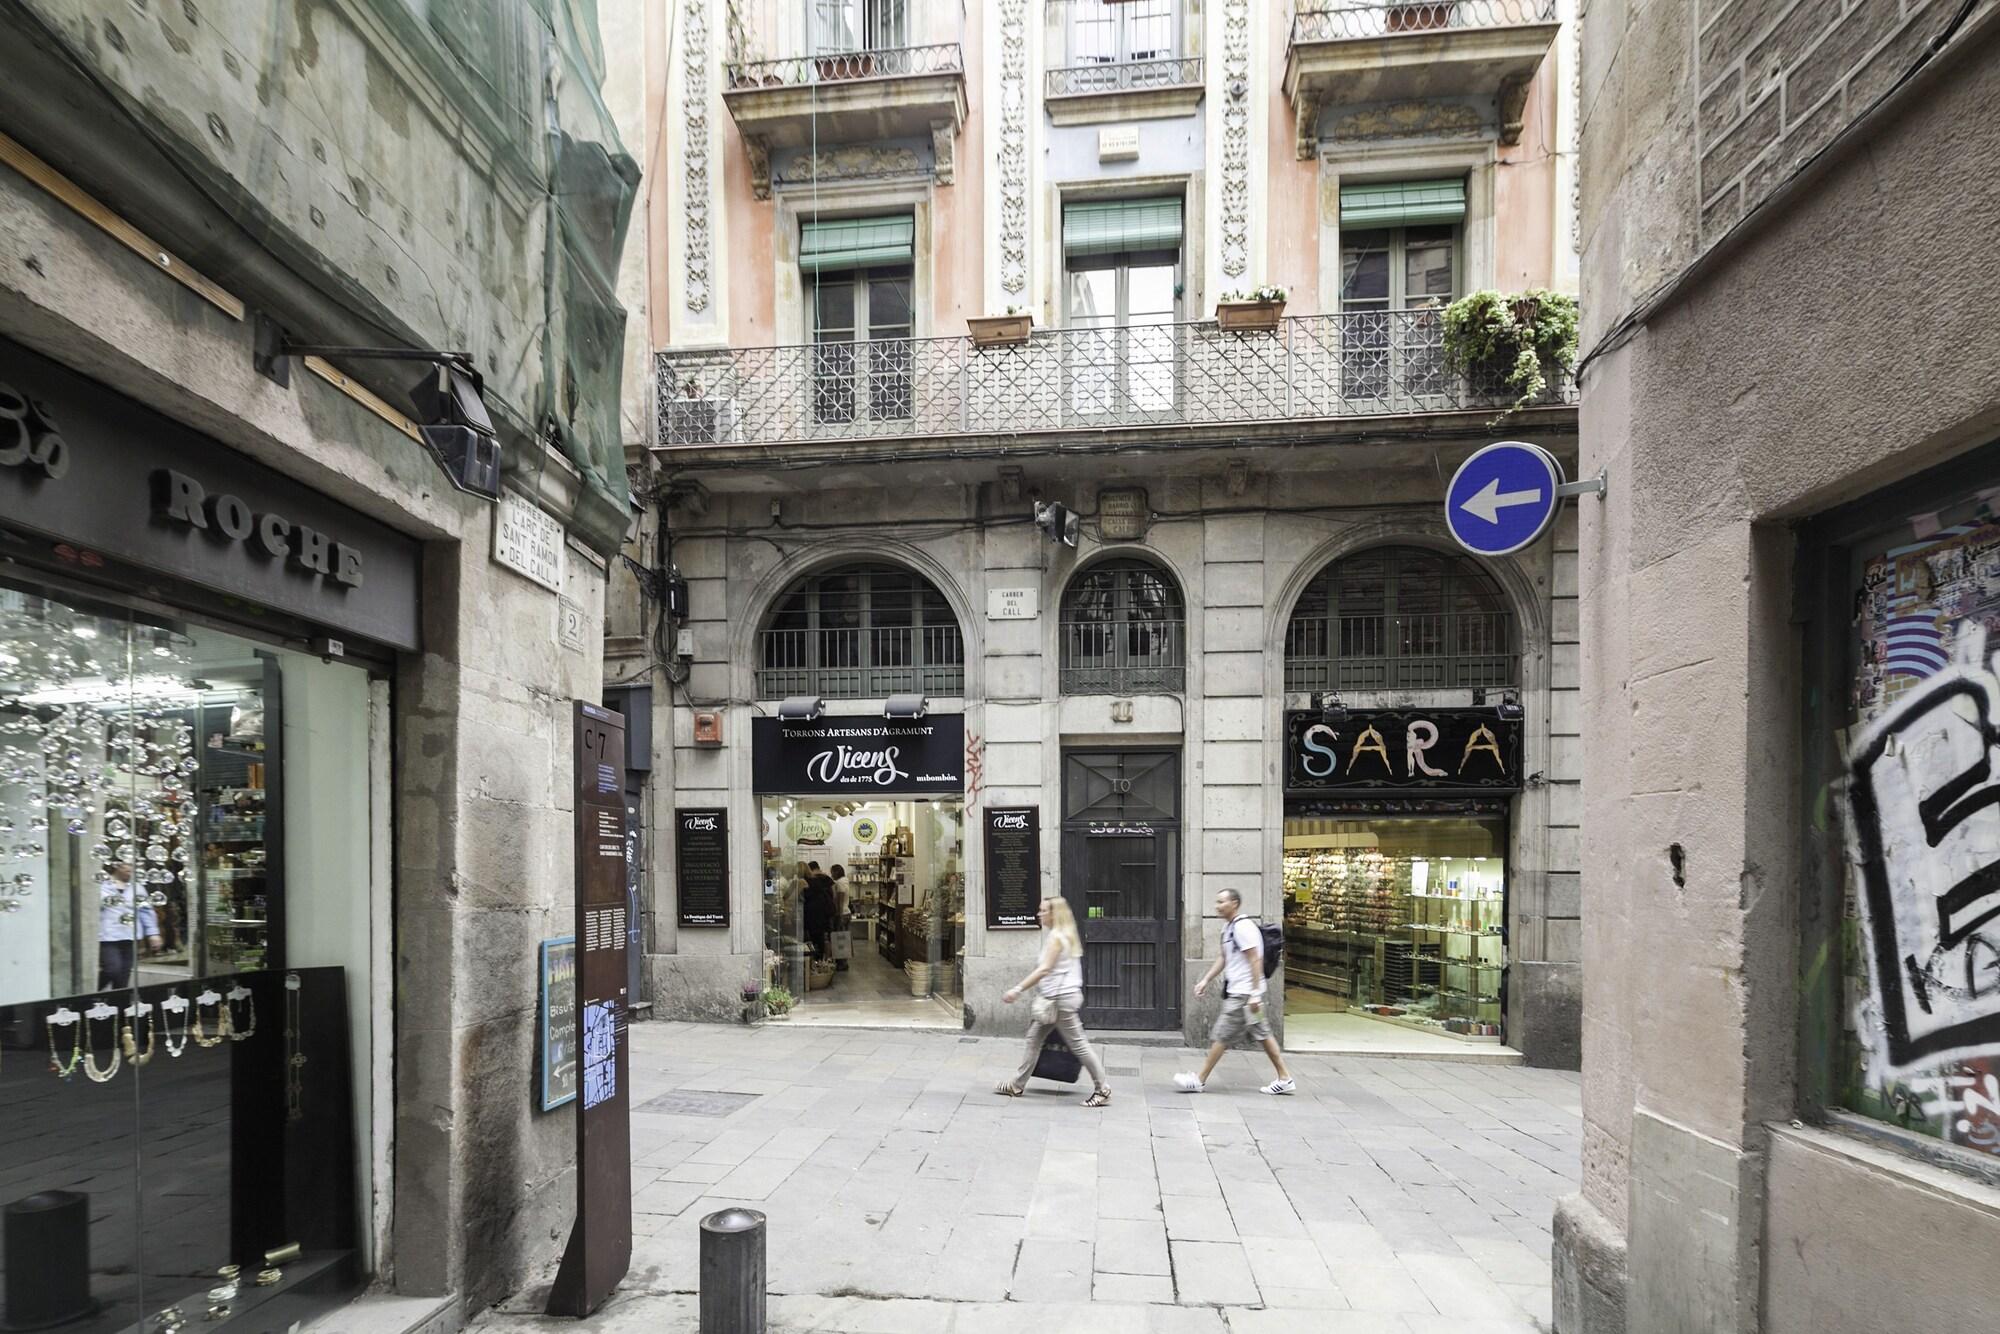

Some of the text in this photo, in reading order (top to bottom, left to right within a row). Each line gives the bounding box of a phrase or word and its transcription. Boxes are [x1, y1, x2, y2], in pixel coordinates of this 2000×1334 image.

[166, 468, 364, 589] ROCHE
[509, 494, 555, 532] CARRER DE
[512, 506, 551, 546] L'ARC DE
[503, 523, 558, 569] SANT RAMON
[509, 546, 552, 584] DEL CALL
[568, 613, 578, 638] 2
[1002, 607, 1022, 616] CALL
[585, 729, 606, 759] C 7
[782, 726, 934, 738] TORRONS ARTESANS D'AGRAMUNT
[1300, 719, 1506, 778] SARA
[807, 745, 909, 786] Vicens
[1112, 778, 1131, 793] 10
[993, 814, 1029, 829] Vicens
